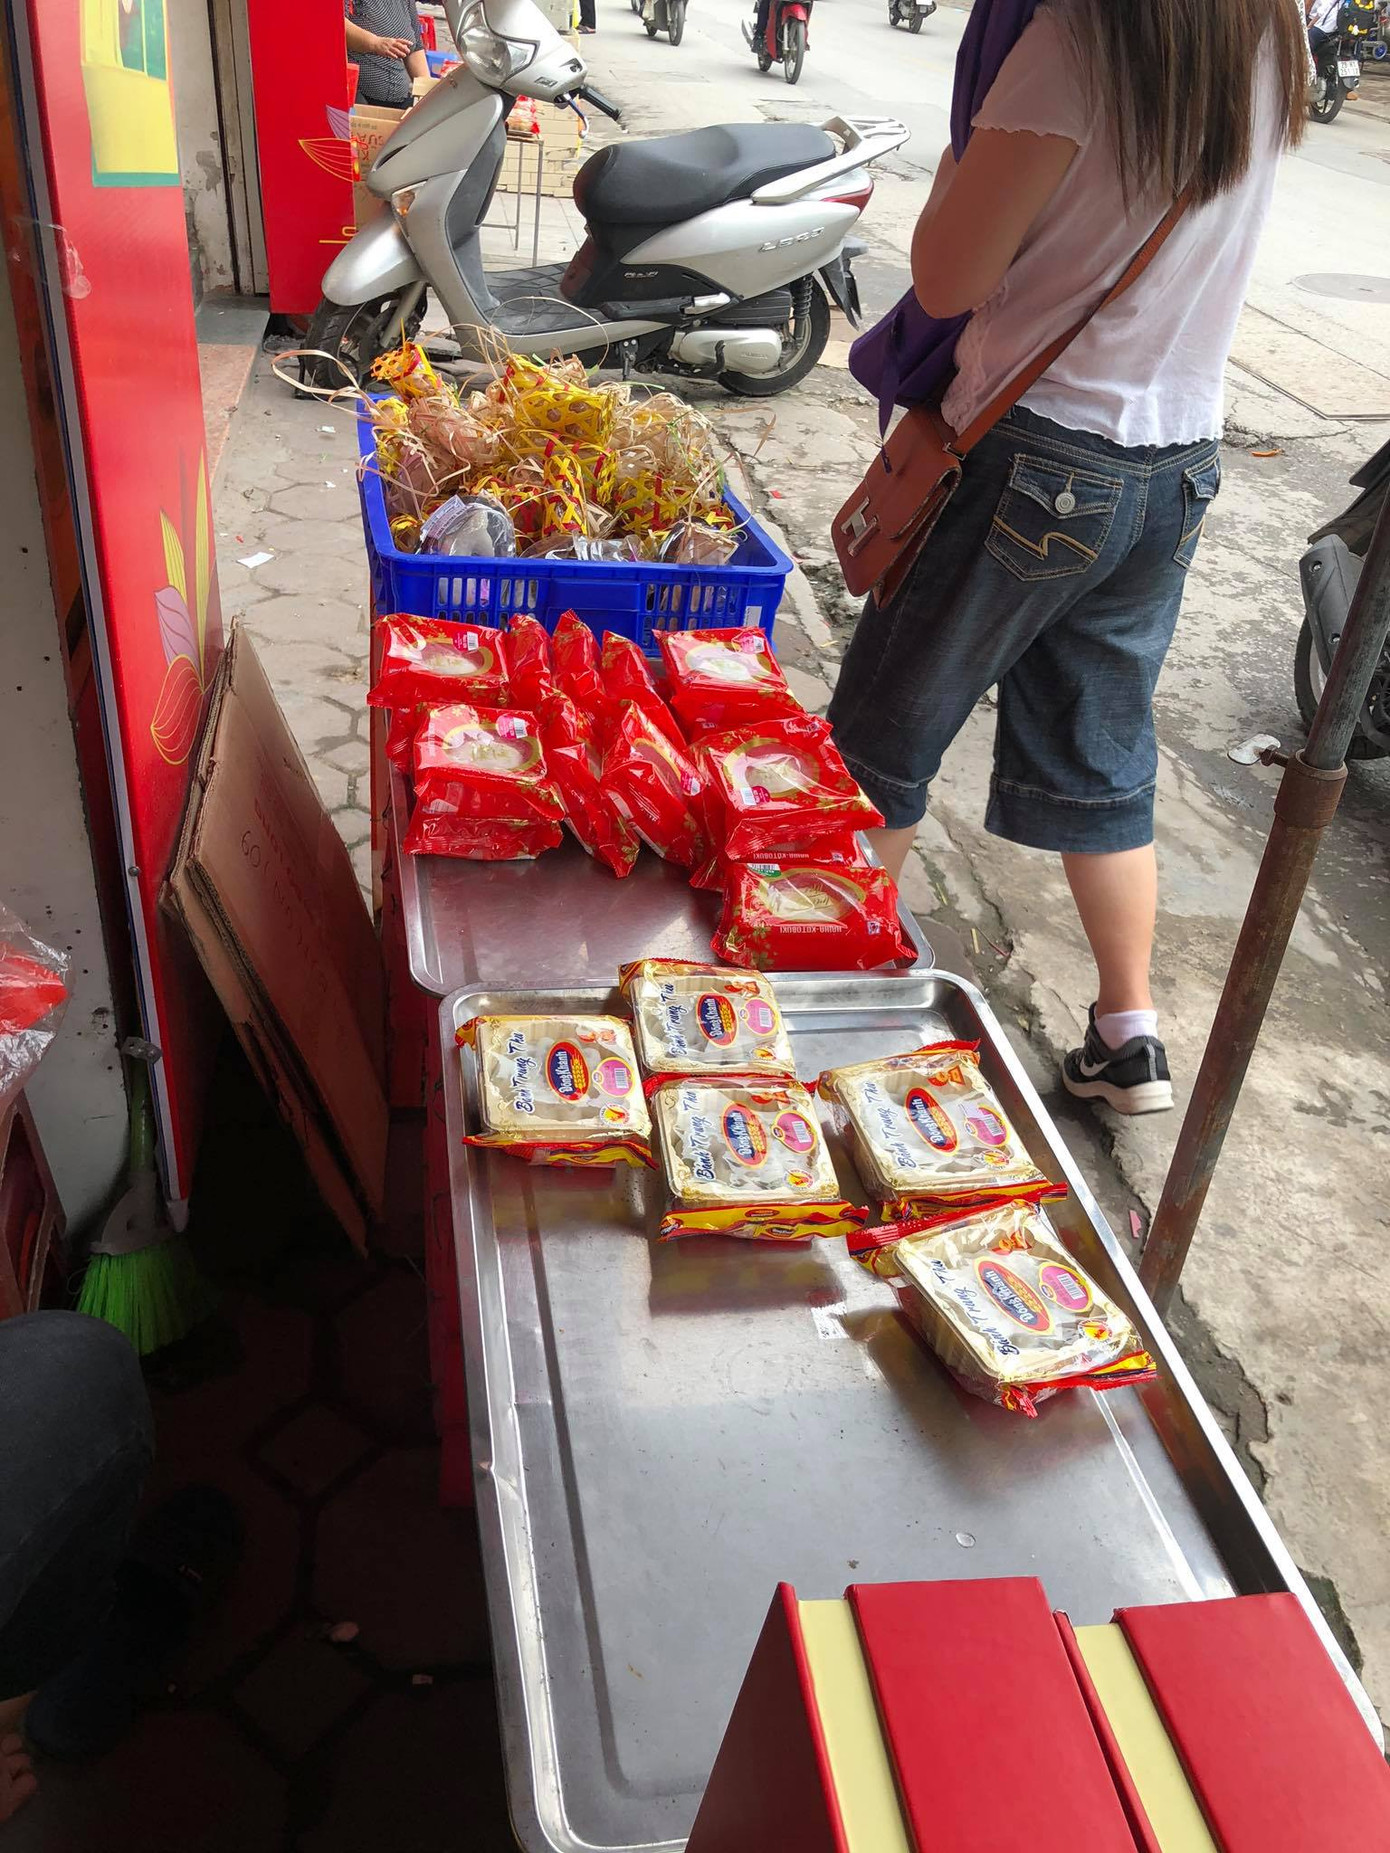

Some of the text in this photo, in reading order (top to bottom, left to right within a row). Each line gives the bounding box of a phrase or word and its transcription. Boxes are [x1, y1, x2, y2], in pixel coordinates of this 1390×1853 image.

[665, 1004, 688, 1031] Trung
[508, 1032, 525, 1054] Thu
[511, 1057, 537, 1087] Trung
[863, 1081, 883, 1103] Thu
[682, 1091, 715, 1180] Bánh Trung Thu
[877, 1107, 903, 1139] Trung
[931, 1259, 955, 1284] Thu
[953, 1286, 989, 1324] Trung
